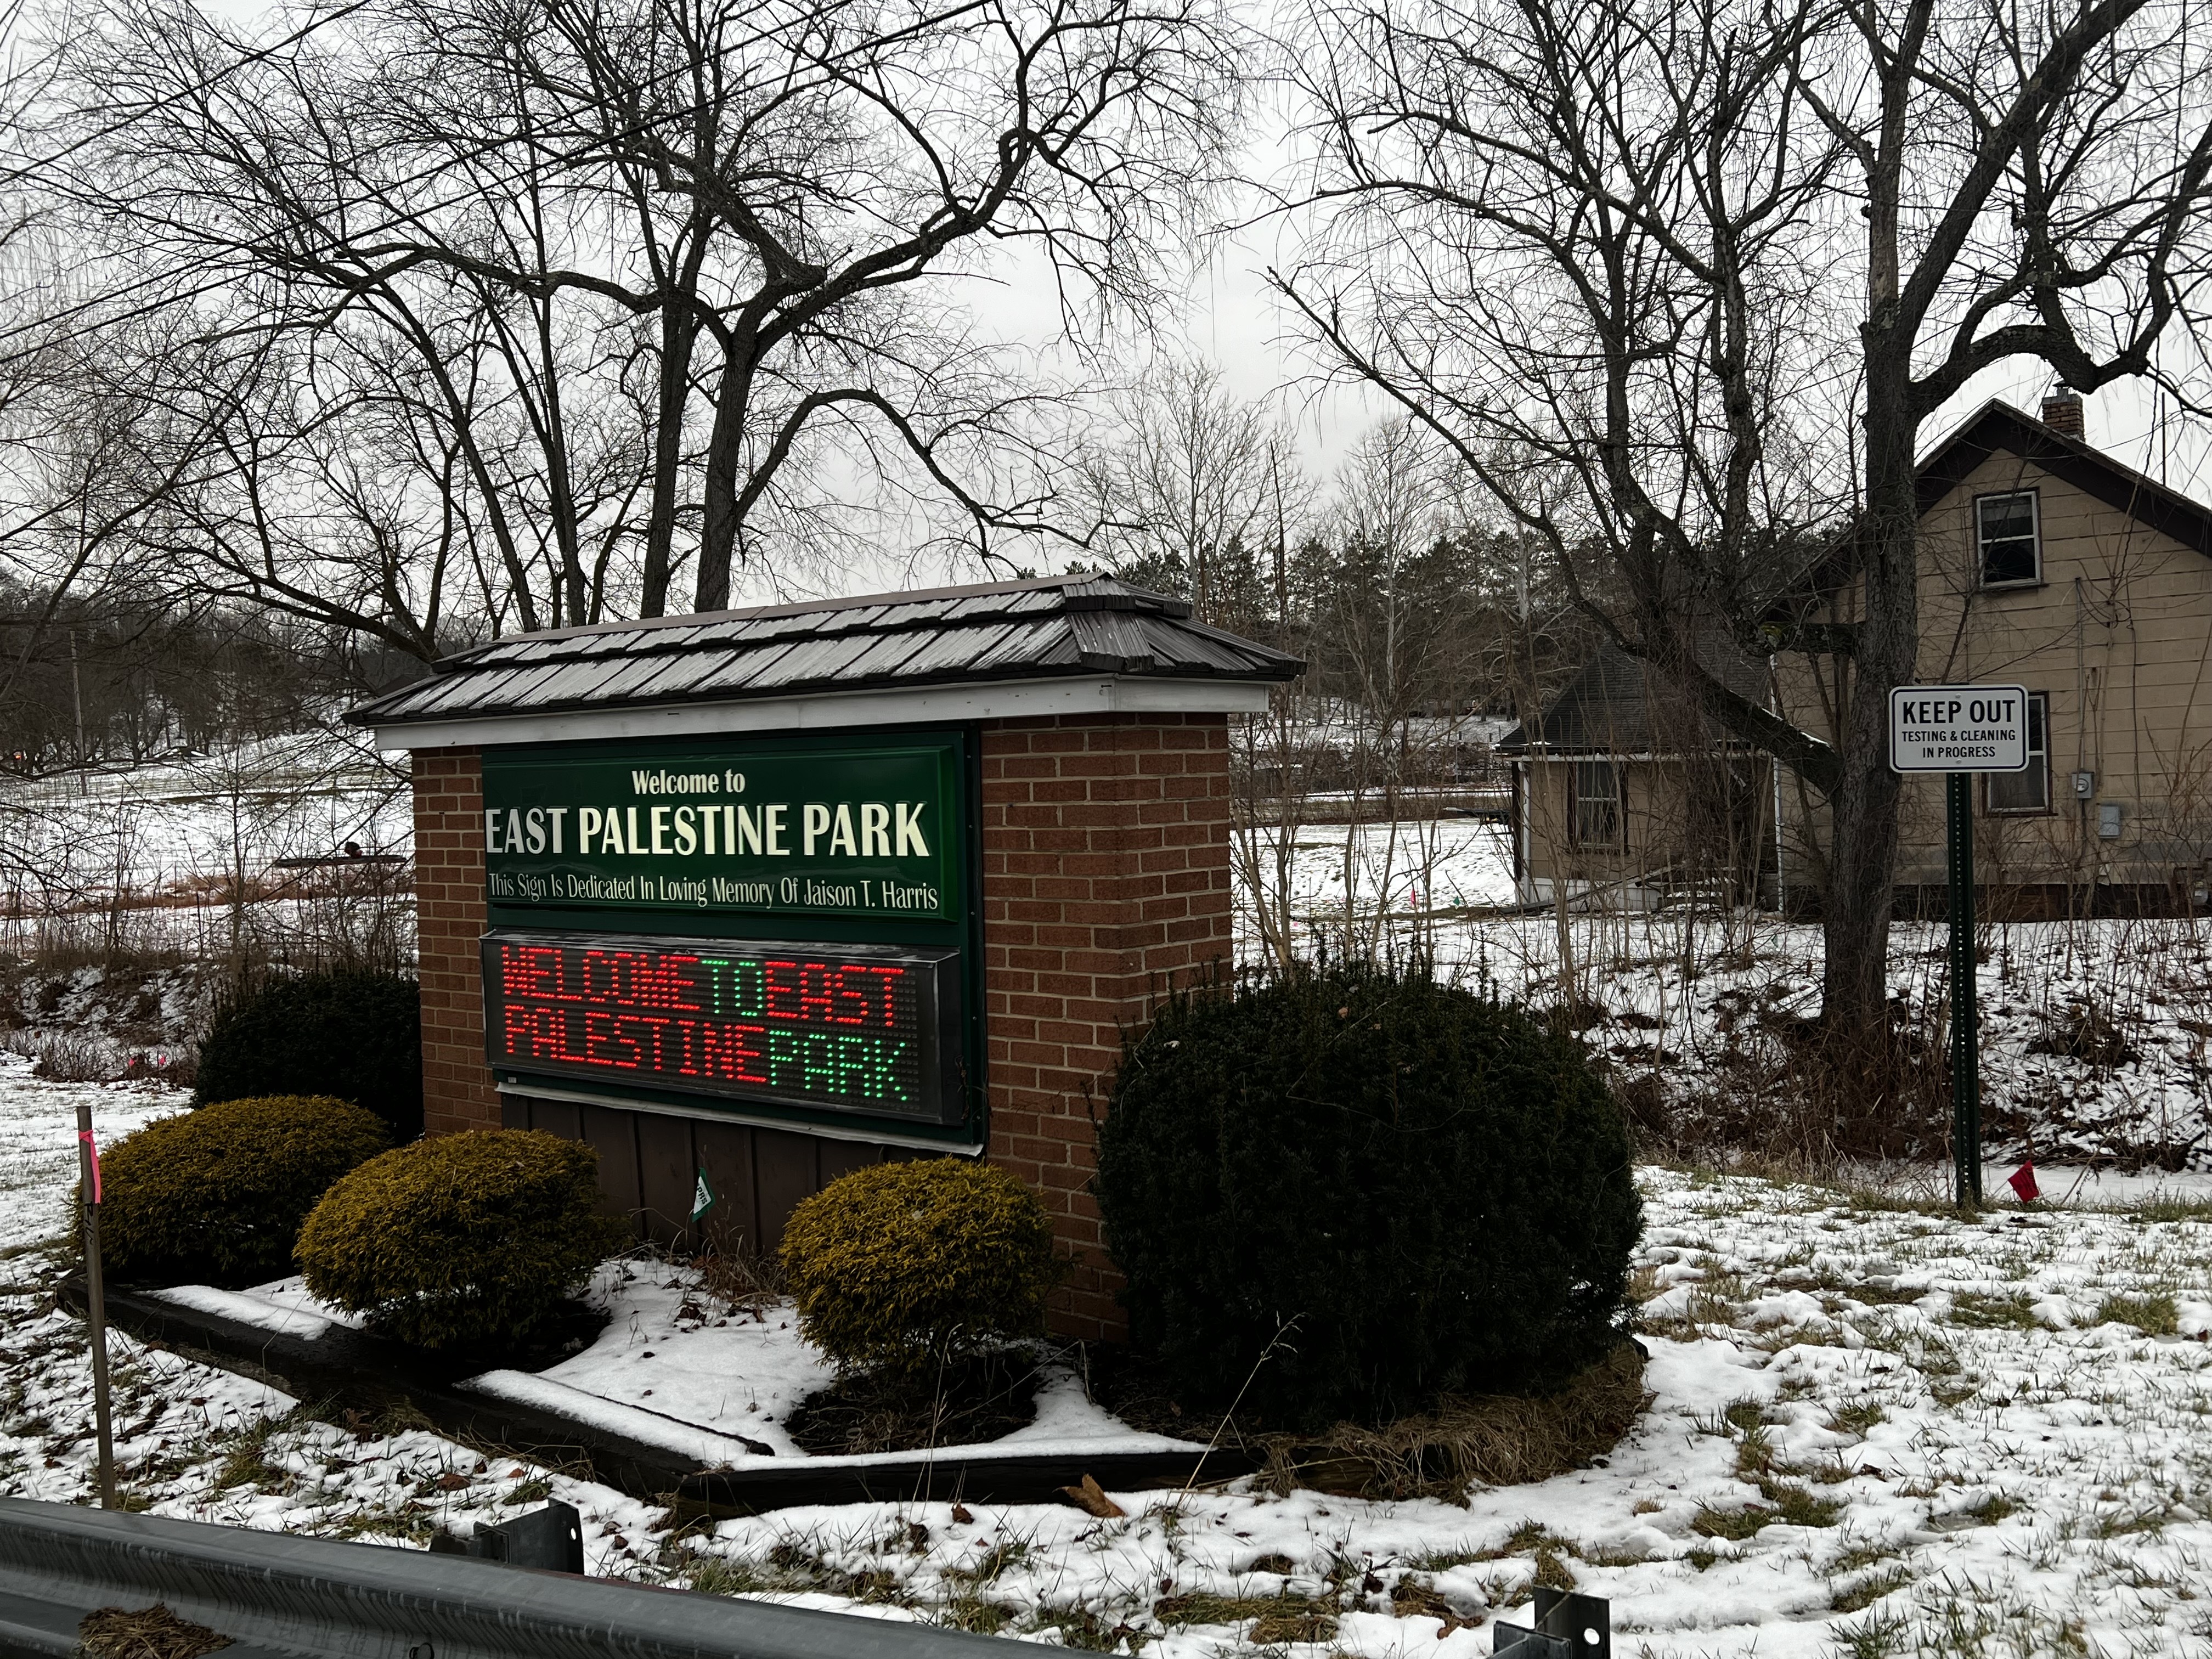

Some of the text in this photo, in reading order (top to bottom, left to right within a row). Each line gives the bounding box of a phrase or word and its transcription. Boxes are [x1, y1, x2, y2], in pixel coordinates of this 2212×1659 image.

[1903, 700, 2015, 724] KEEP OUT
[1902, 730, 2015, 742] TESTING & CLEANING
[1923, 747, 1995, 758] IN PROGRESS
[632, 769, 745, 794] Welcome to
[486, 803, 929, 856] EAST PALESTINE PARK
[489, 873, 938, 909] This Sign Is Dedicated In Loving Memory Of Jaison T. Harris
[501, 946, 904, 1026] WELCOME TO EAST
[505, 1005, 907, 1101] PALESTINE PARK
